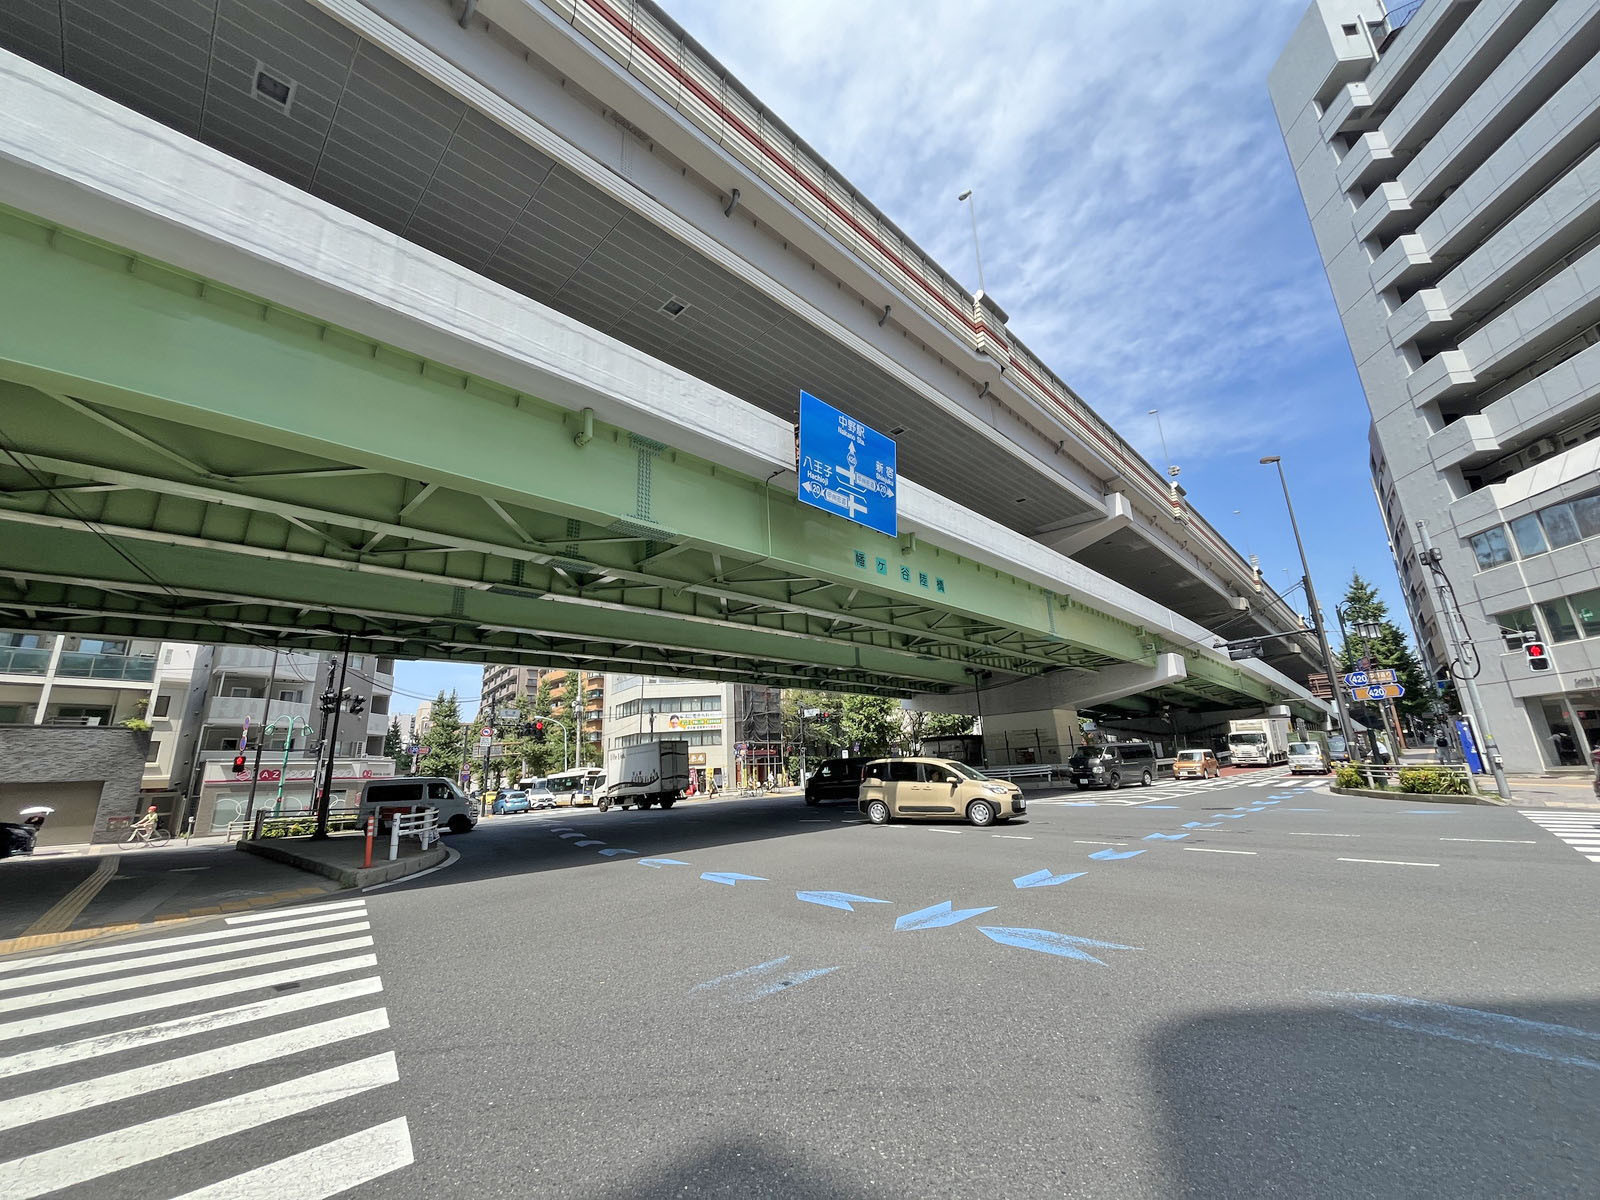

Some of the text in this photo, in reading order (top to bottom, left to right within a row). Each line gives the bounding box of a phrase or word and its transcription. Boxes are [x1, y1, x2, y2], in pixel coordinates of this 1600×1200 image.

[838, 415, 866, 440] 中野駅
[803, 455, 833, 478] 八王子
[875, 460, 894, 480] 新宿
[807, 470, 829, 487] Hachioji
[812, 483, 821, 495] 20
[1352, 675, 1368, 683] 420
[1369, 688, 1385, 696] 420
